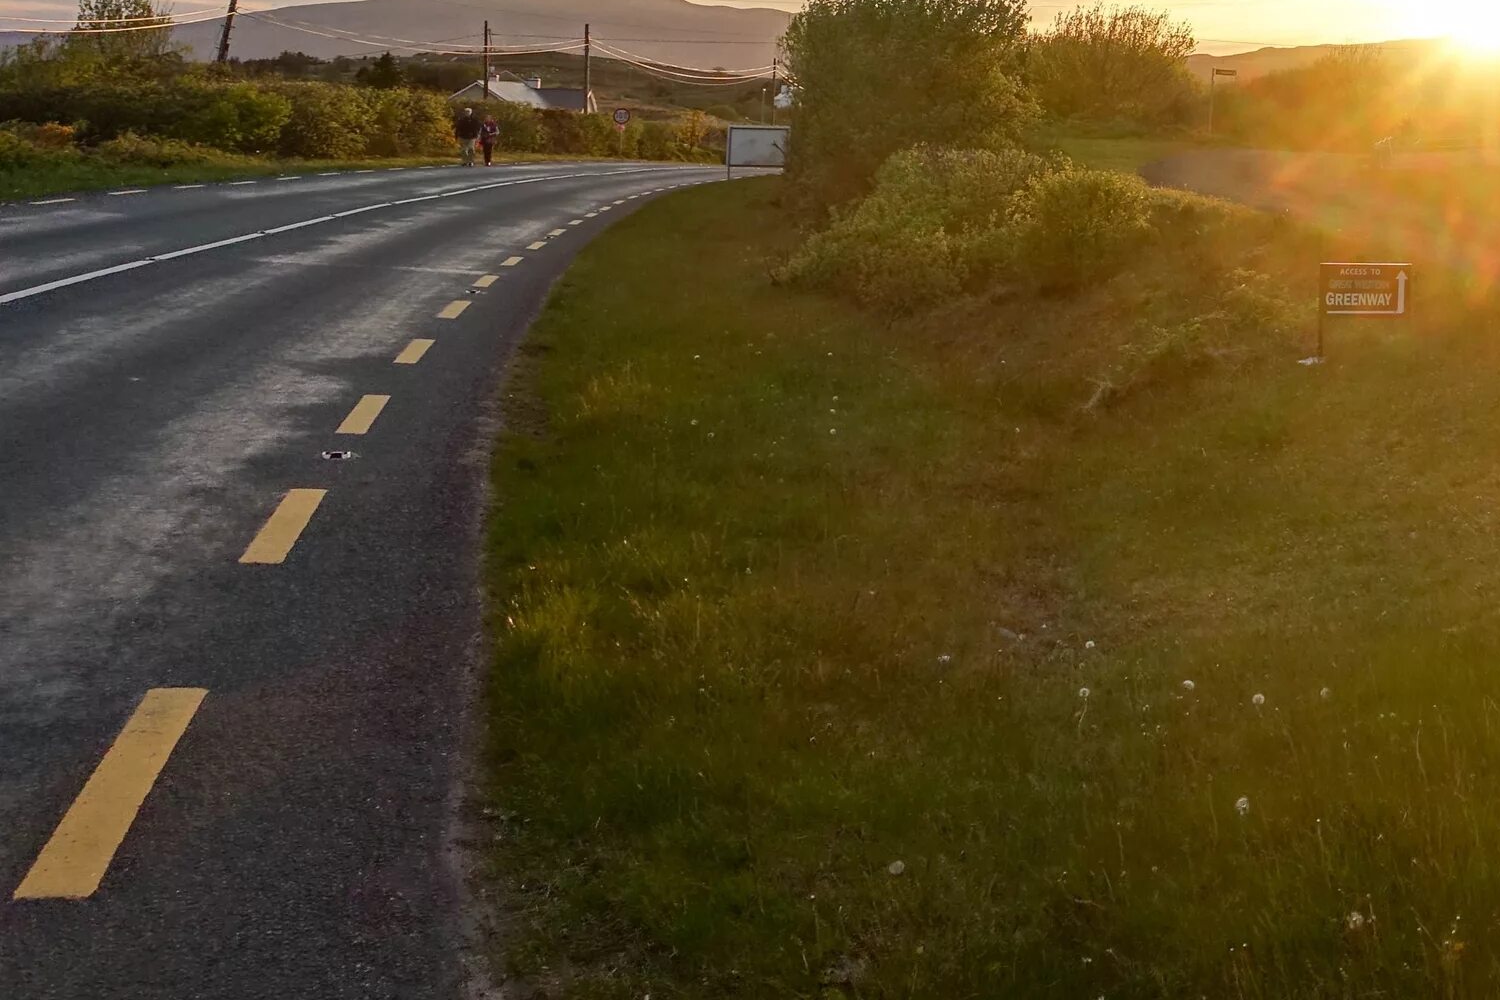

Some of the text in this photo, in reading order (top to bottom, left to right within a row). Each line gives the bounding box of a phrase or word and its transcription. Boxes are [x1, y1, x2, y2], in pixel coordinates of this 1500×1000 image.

[1340, 268, 1381, 276] ACCESS TO
[1325, 292, 1392, 306] GREENWAY
